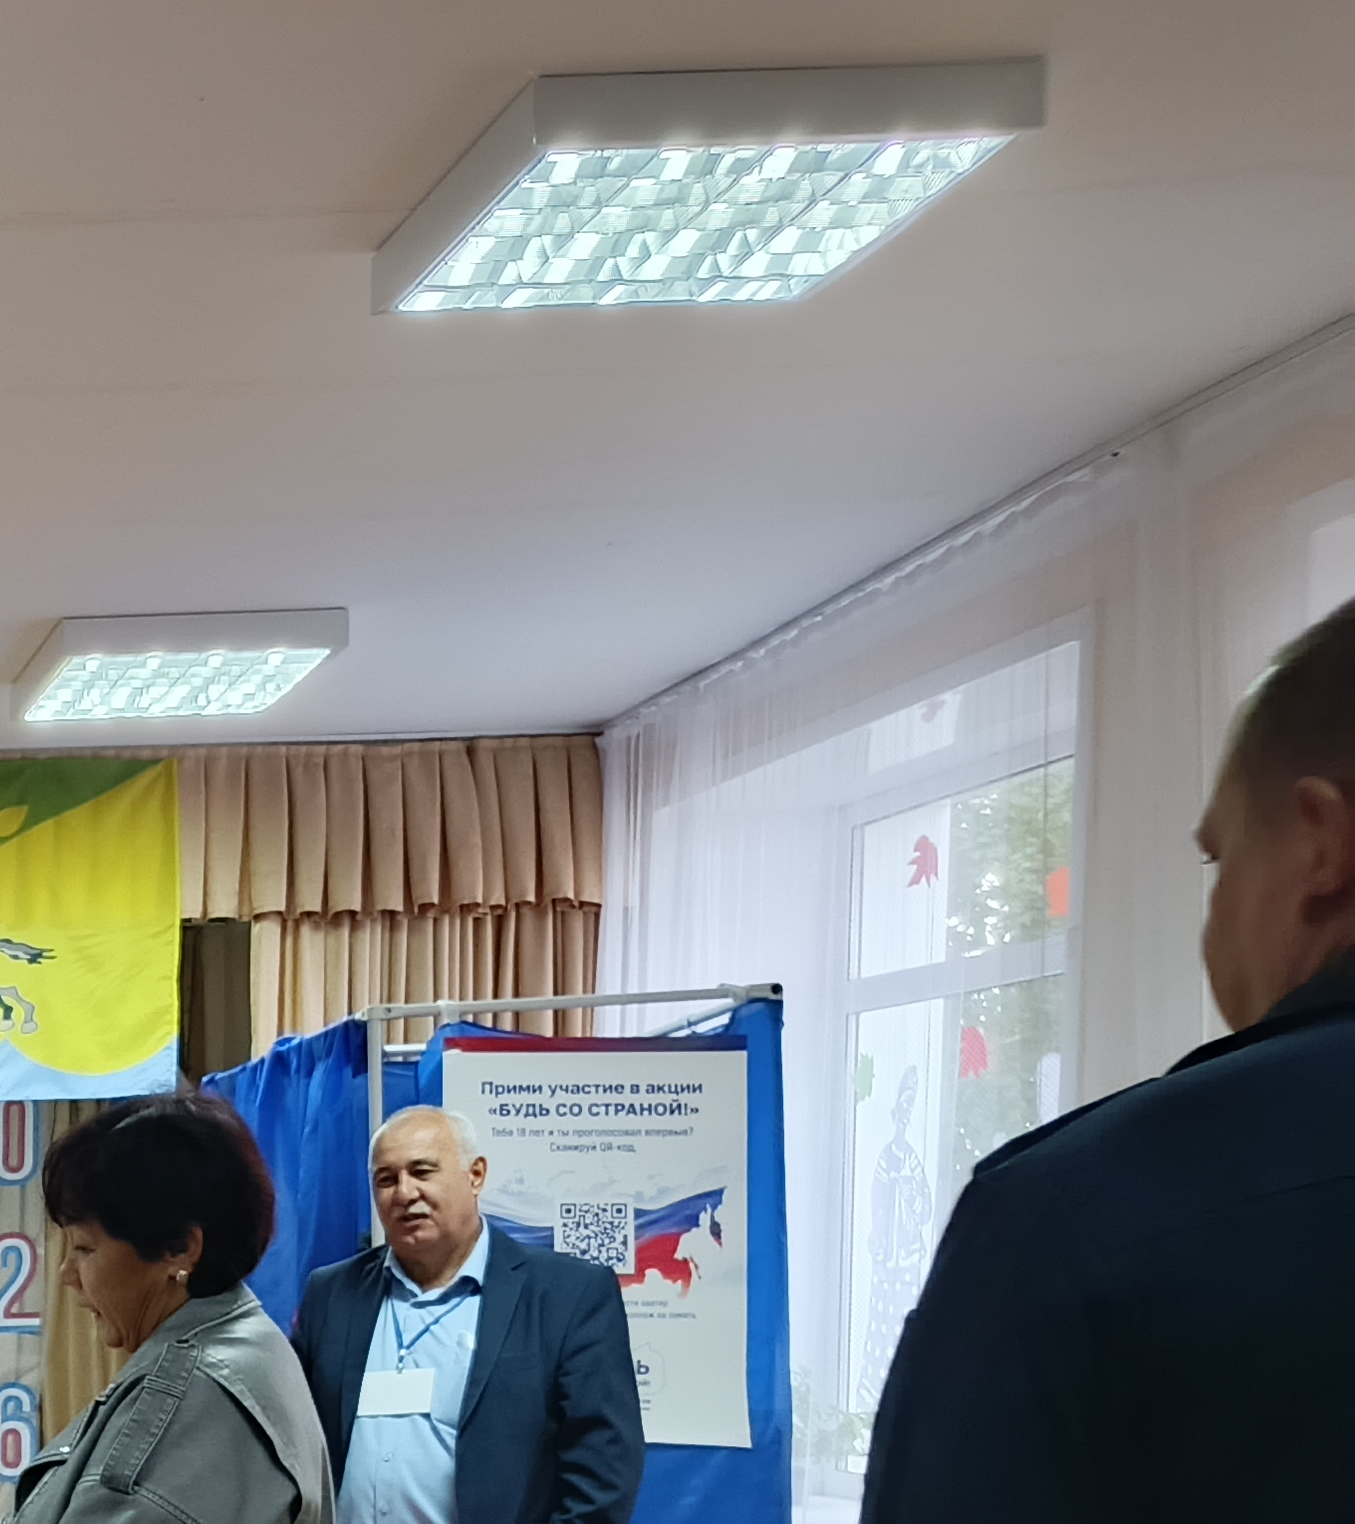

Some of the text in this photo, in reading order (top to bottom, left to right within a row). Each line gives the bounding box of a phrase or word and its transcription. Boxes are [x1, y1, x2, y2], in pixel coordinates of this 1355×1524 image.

[481, 1081, 703, 1098] Прими участие в акции
[487, 1099, 700, 1119] «БУДЬ СО СТРАНОЙ!»
[516, 1127, 526, 1137] 18
[528, 1128, 544, 1138] лет
[557, 1129, 569, 1137] ты
